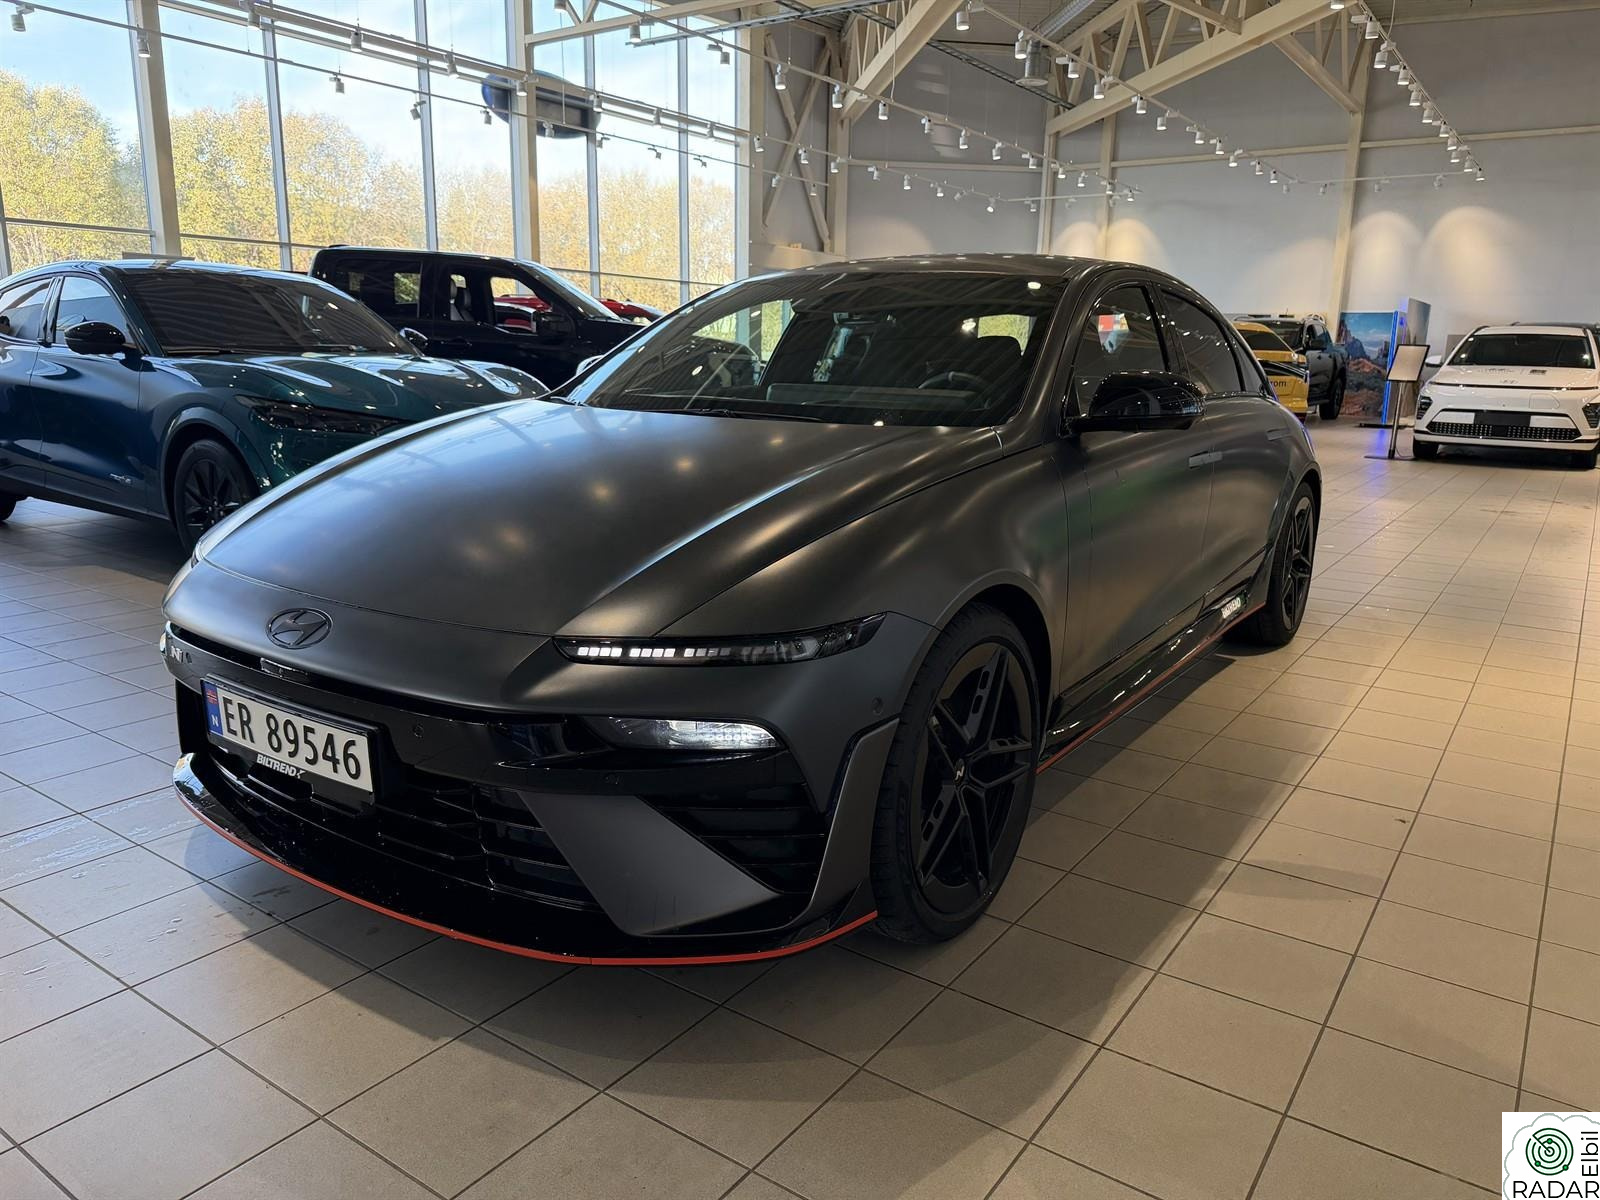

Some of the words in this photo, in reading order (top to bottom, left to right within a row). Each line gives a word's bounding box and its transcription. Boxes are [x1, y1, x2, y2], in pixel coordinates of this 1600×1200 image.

[210, 713, 219, 728] N
[222, 696, 256, 744] ER
[265, 712, 362, 780] 89546
[256, 753, 297, 777] BILTREND
